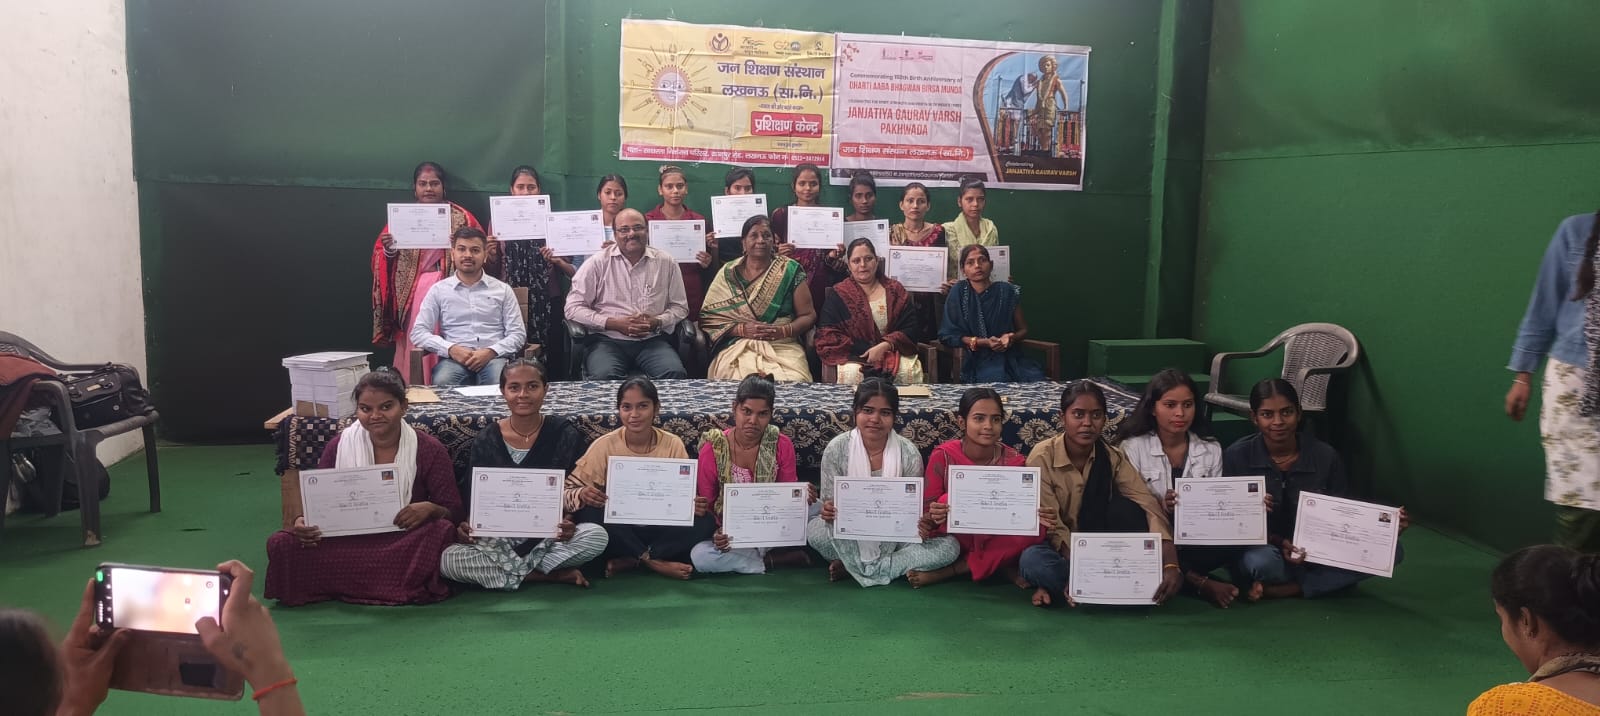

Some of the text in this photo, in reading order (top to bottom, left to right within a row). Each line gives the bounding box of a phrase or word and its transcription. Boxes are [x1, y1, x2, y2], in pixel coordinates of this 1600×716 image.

[717, 59, 825, 79] जन शिक्षण संस्थान
[721, 84, 769, 97] लखनऊ
[849, 81, 963, 94] DHARTI AABA BHAGWAN BIRSA MUNDA
[848, 107, 962, 123] JANJATIYA GAURAV VARSH
[754, 114, 819, 135] प्रशिक्षण केन्द्र
[880, 123, 928, 136] PAKHWADA
